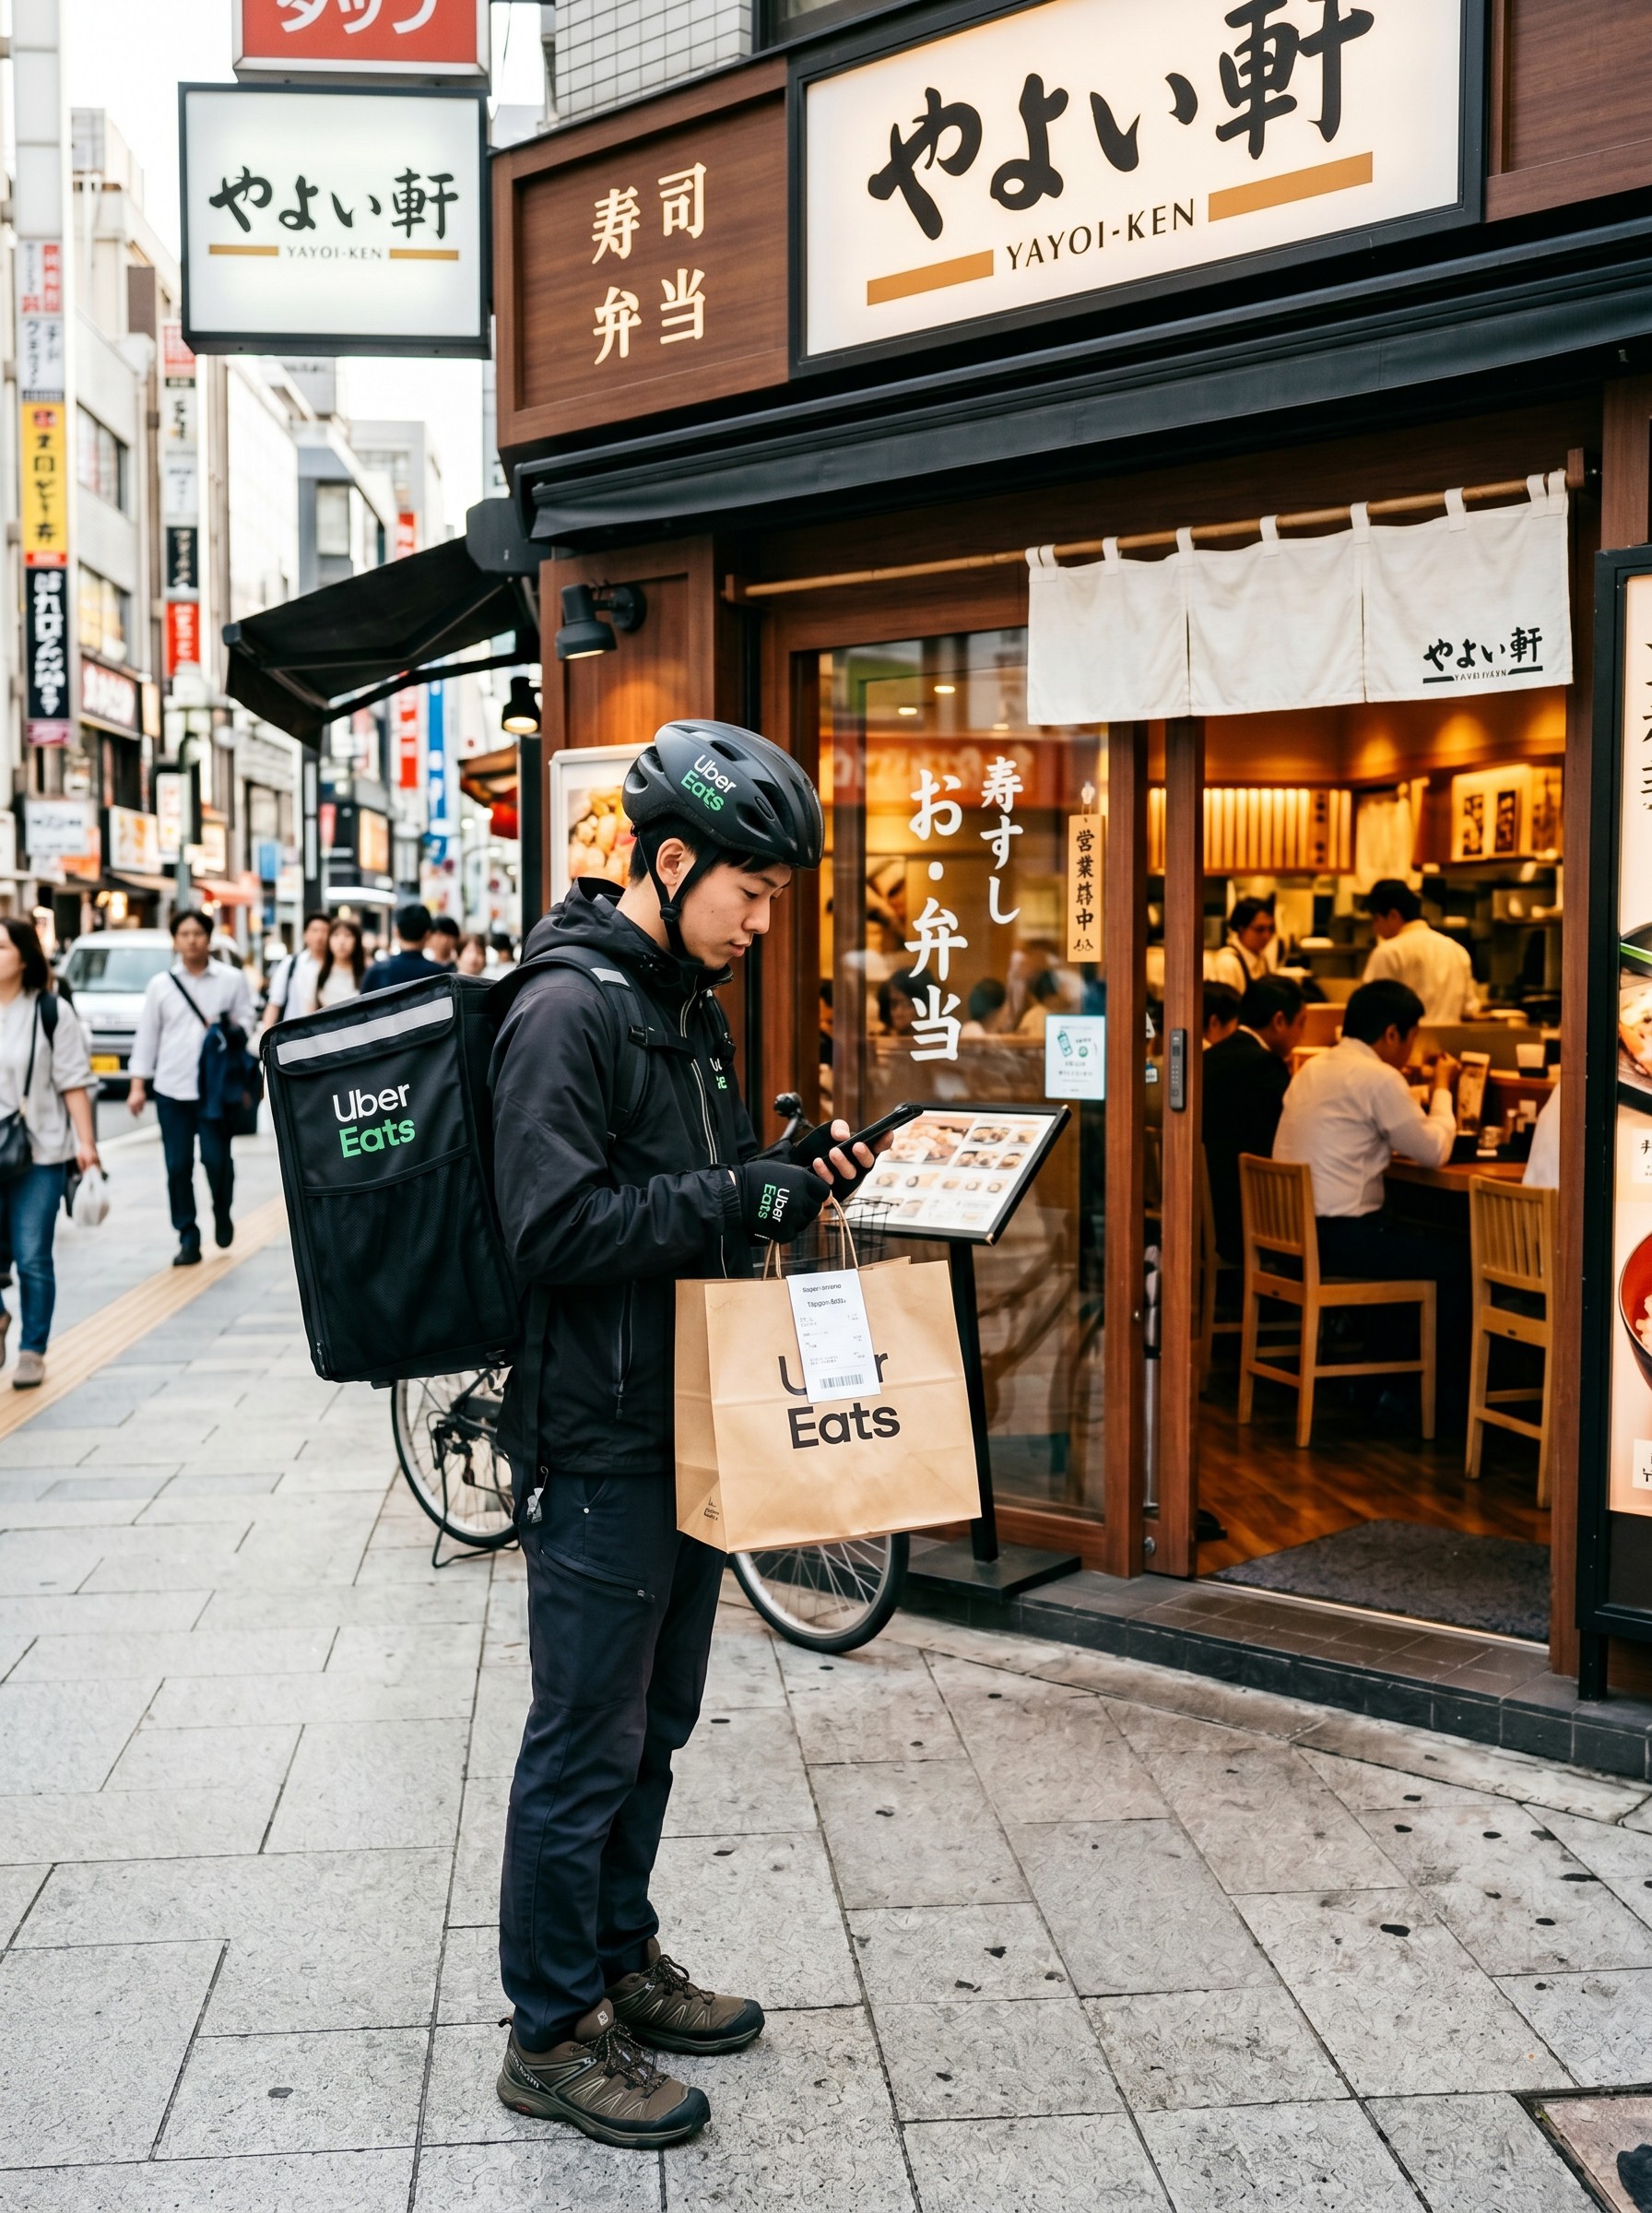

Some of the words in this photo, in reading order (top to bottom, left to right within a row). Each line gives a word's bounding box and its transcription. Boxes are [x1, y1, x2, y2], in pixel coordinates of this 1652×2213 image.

[867, 0, 1375, 241] やよい軒
[208, 166, 459, 239] やよい軒
[592, 162, 707, 265] 寿司
[287, 246, 384, 259] YAYOI-KEN
[1006, 198, 1196, 270] YAYOI-KEN
[593, 268, 706, 365] 弁当
[1422, 626, 1543, 672] やよい軒
[680, 769, 724, 811] Eats
[693, 754, 737, 793] Uber
[980, 756, 1023, 924] 寿すし
[333, 1083, 410, 1122] Uber
[338, 1118, 416, 1158] Eats
[758, 1183, 777, 1219] Eats
[772, 1188, 790, 1223] Uber
[778, 1353, 889, 1396] Ur
[787, 1402, 901, 1449] Eats
